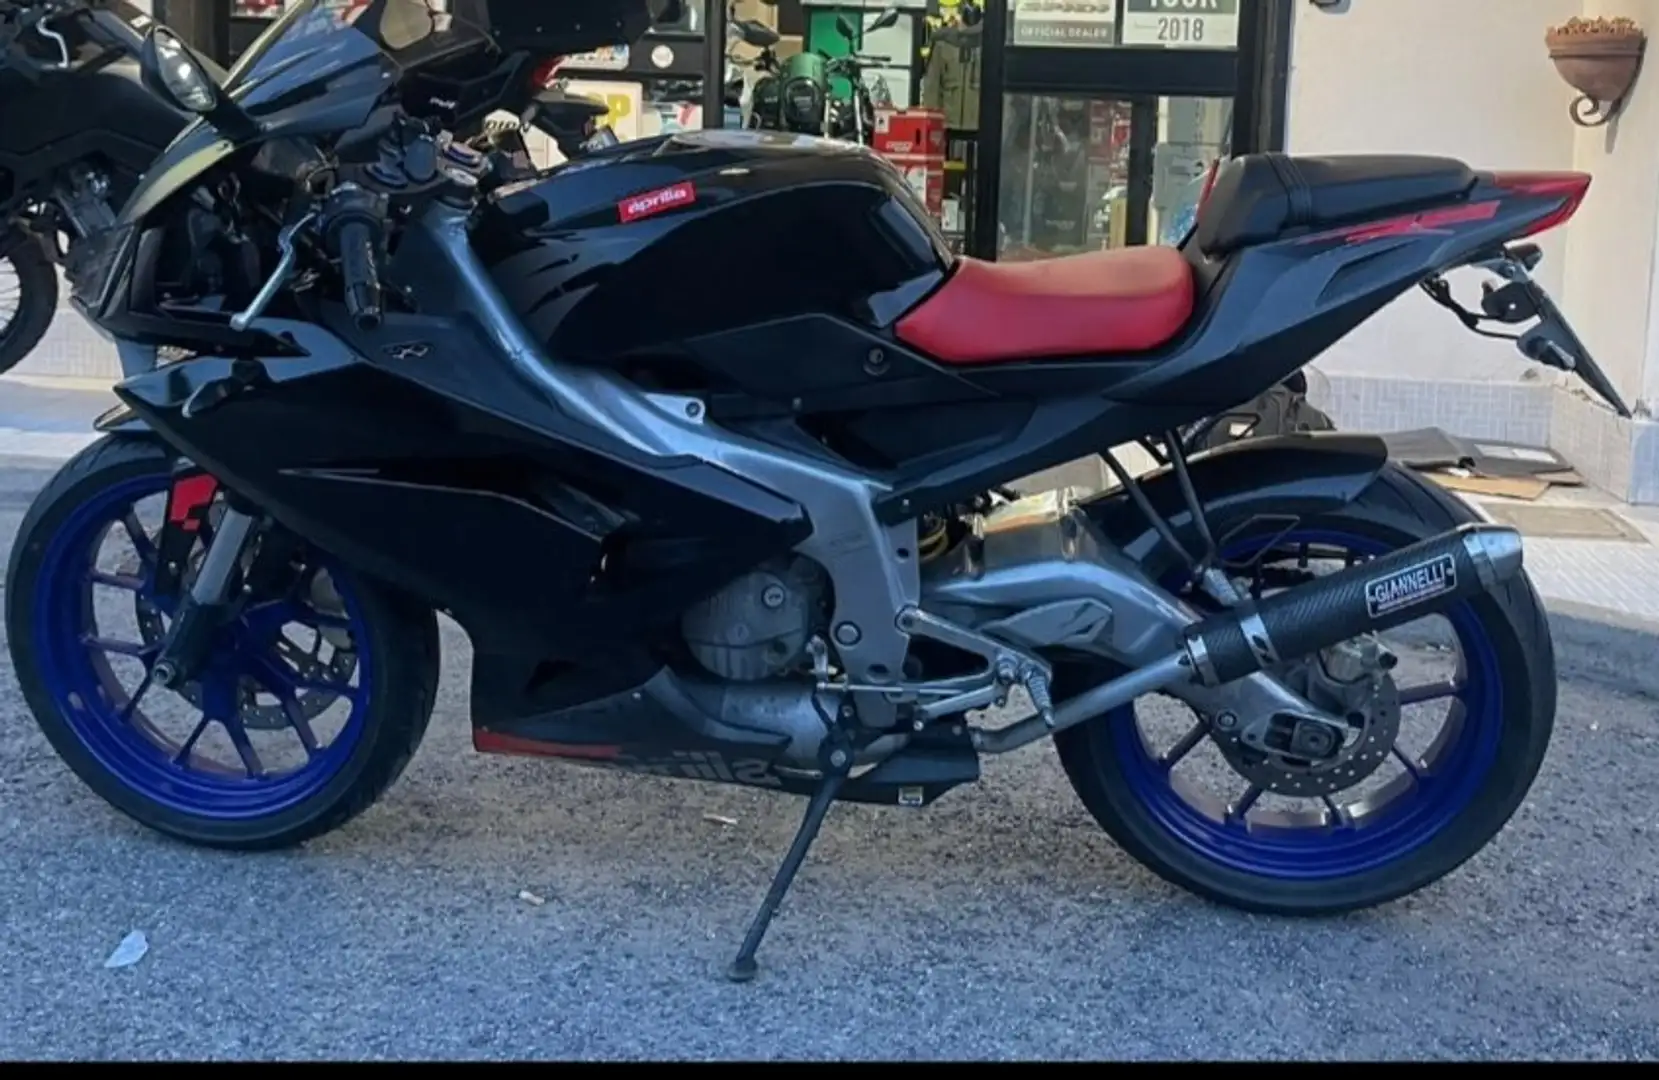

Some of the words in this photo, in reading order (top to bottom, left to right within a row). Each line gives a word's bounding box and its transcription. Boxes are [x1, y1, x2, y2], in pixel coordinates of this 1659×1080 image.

[1158, 16, 1204, 41] 2018
[627, 187, 687, 214] aprilia
[1374, 561, 1446, 603] GIANNELLI
